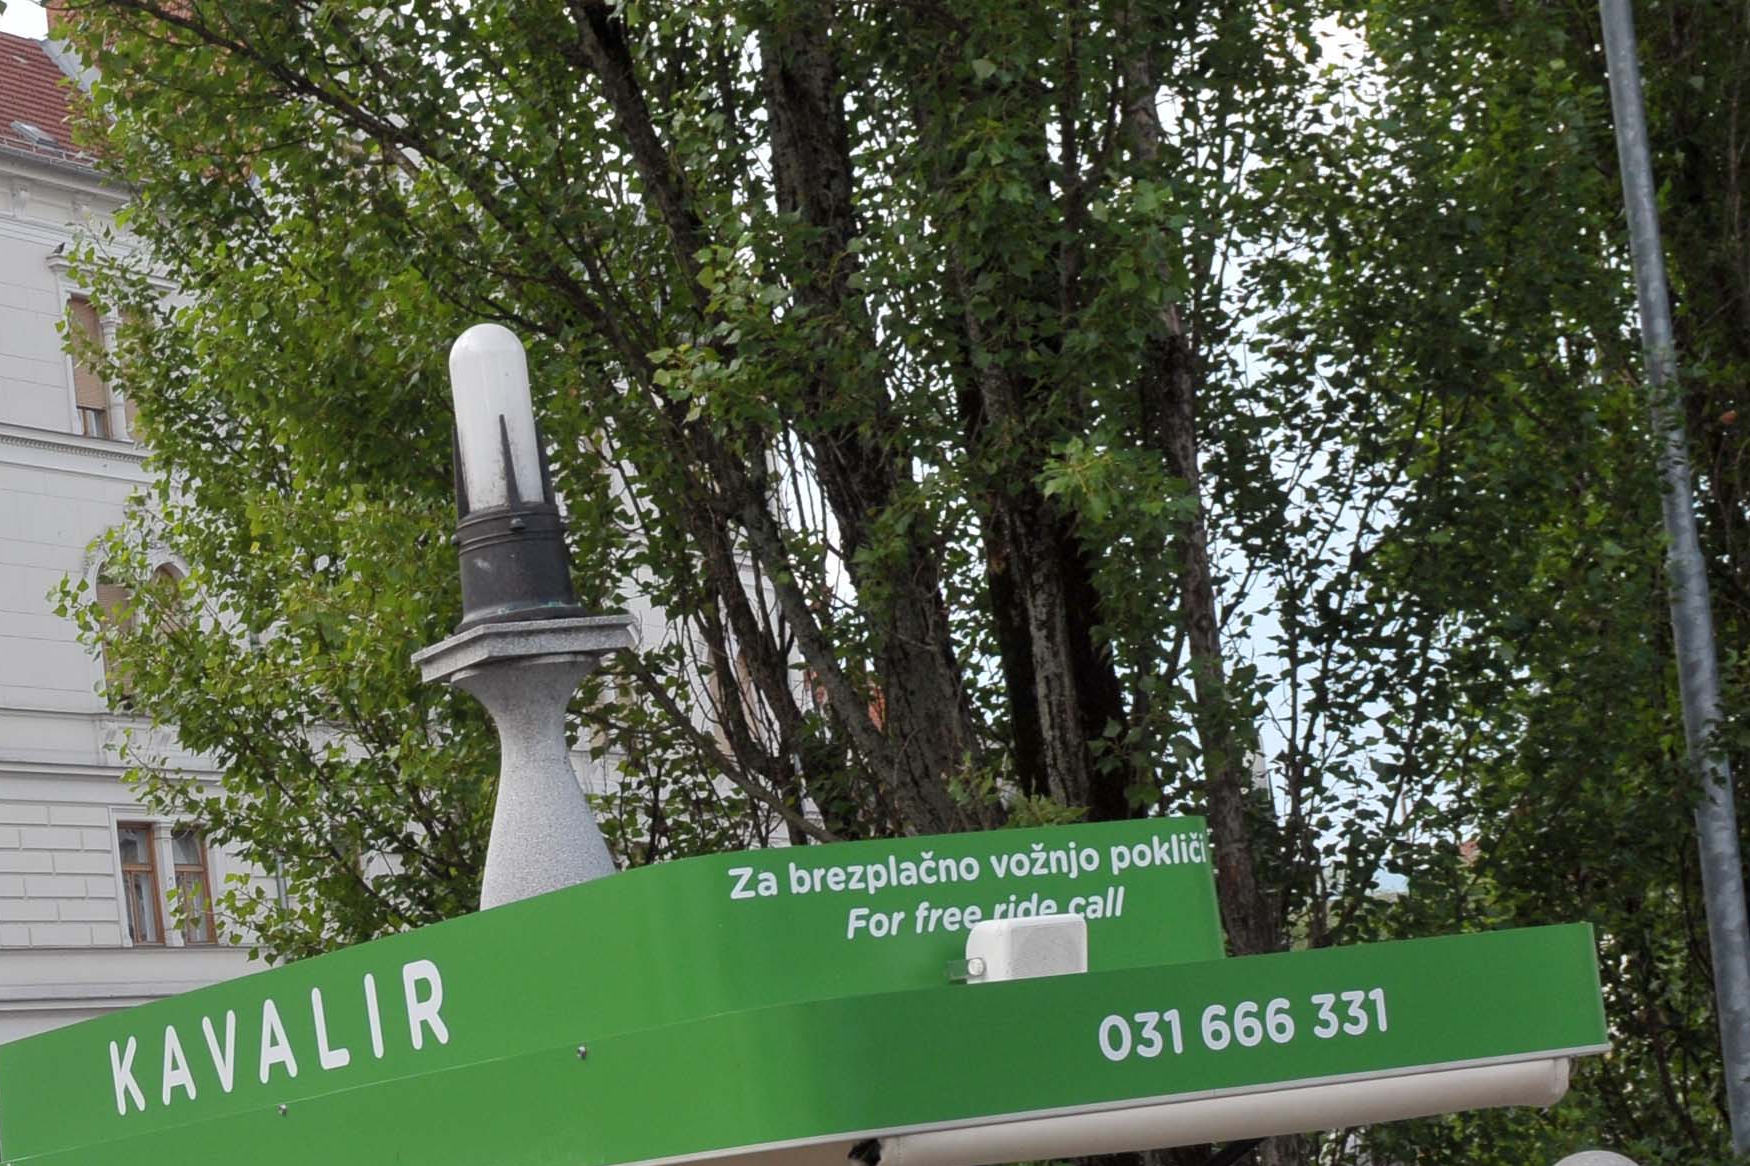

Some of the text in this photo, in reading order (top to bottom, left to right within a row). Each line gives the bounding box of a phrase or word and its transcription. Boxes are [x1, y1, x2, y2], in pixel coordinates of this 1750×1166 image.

[728, 832, 1207, 899] Za brezplačno vožnjo pokliči
[847, 886, 1125, 940] For free ride call
[109, 959, 449, 1116] KAVALIR
[1098, 987, 1388, 1062] 031 666 331
